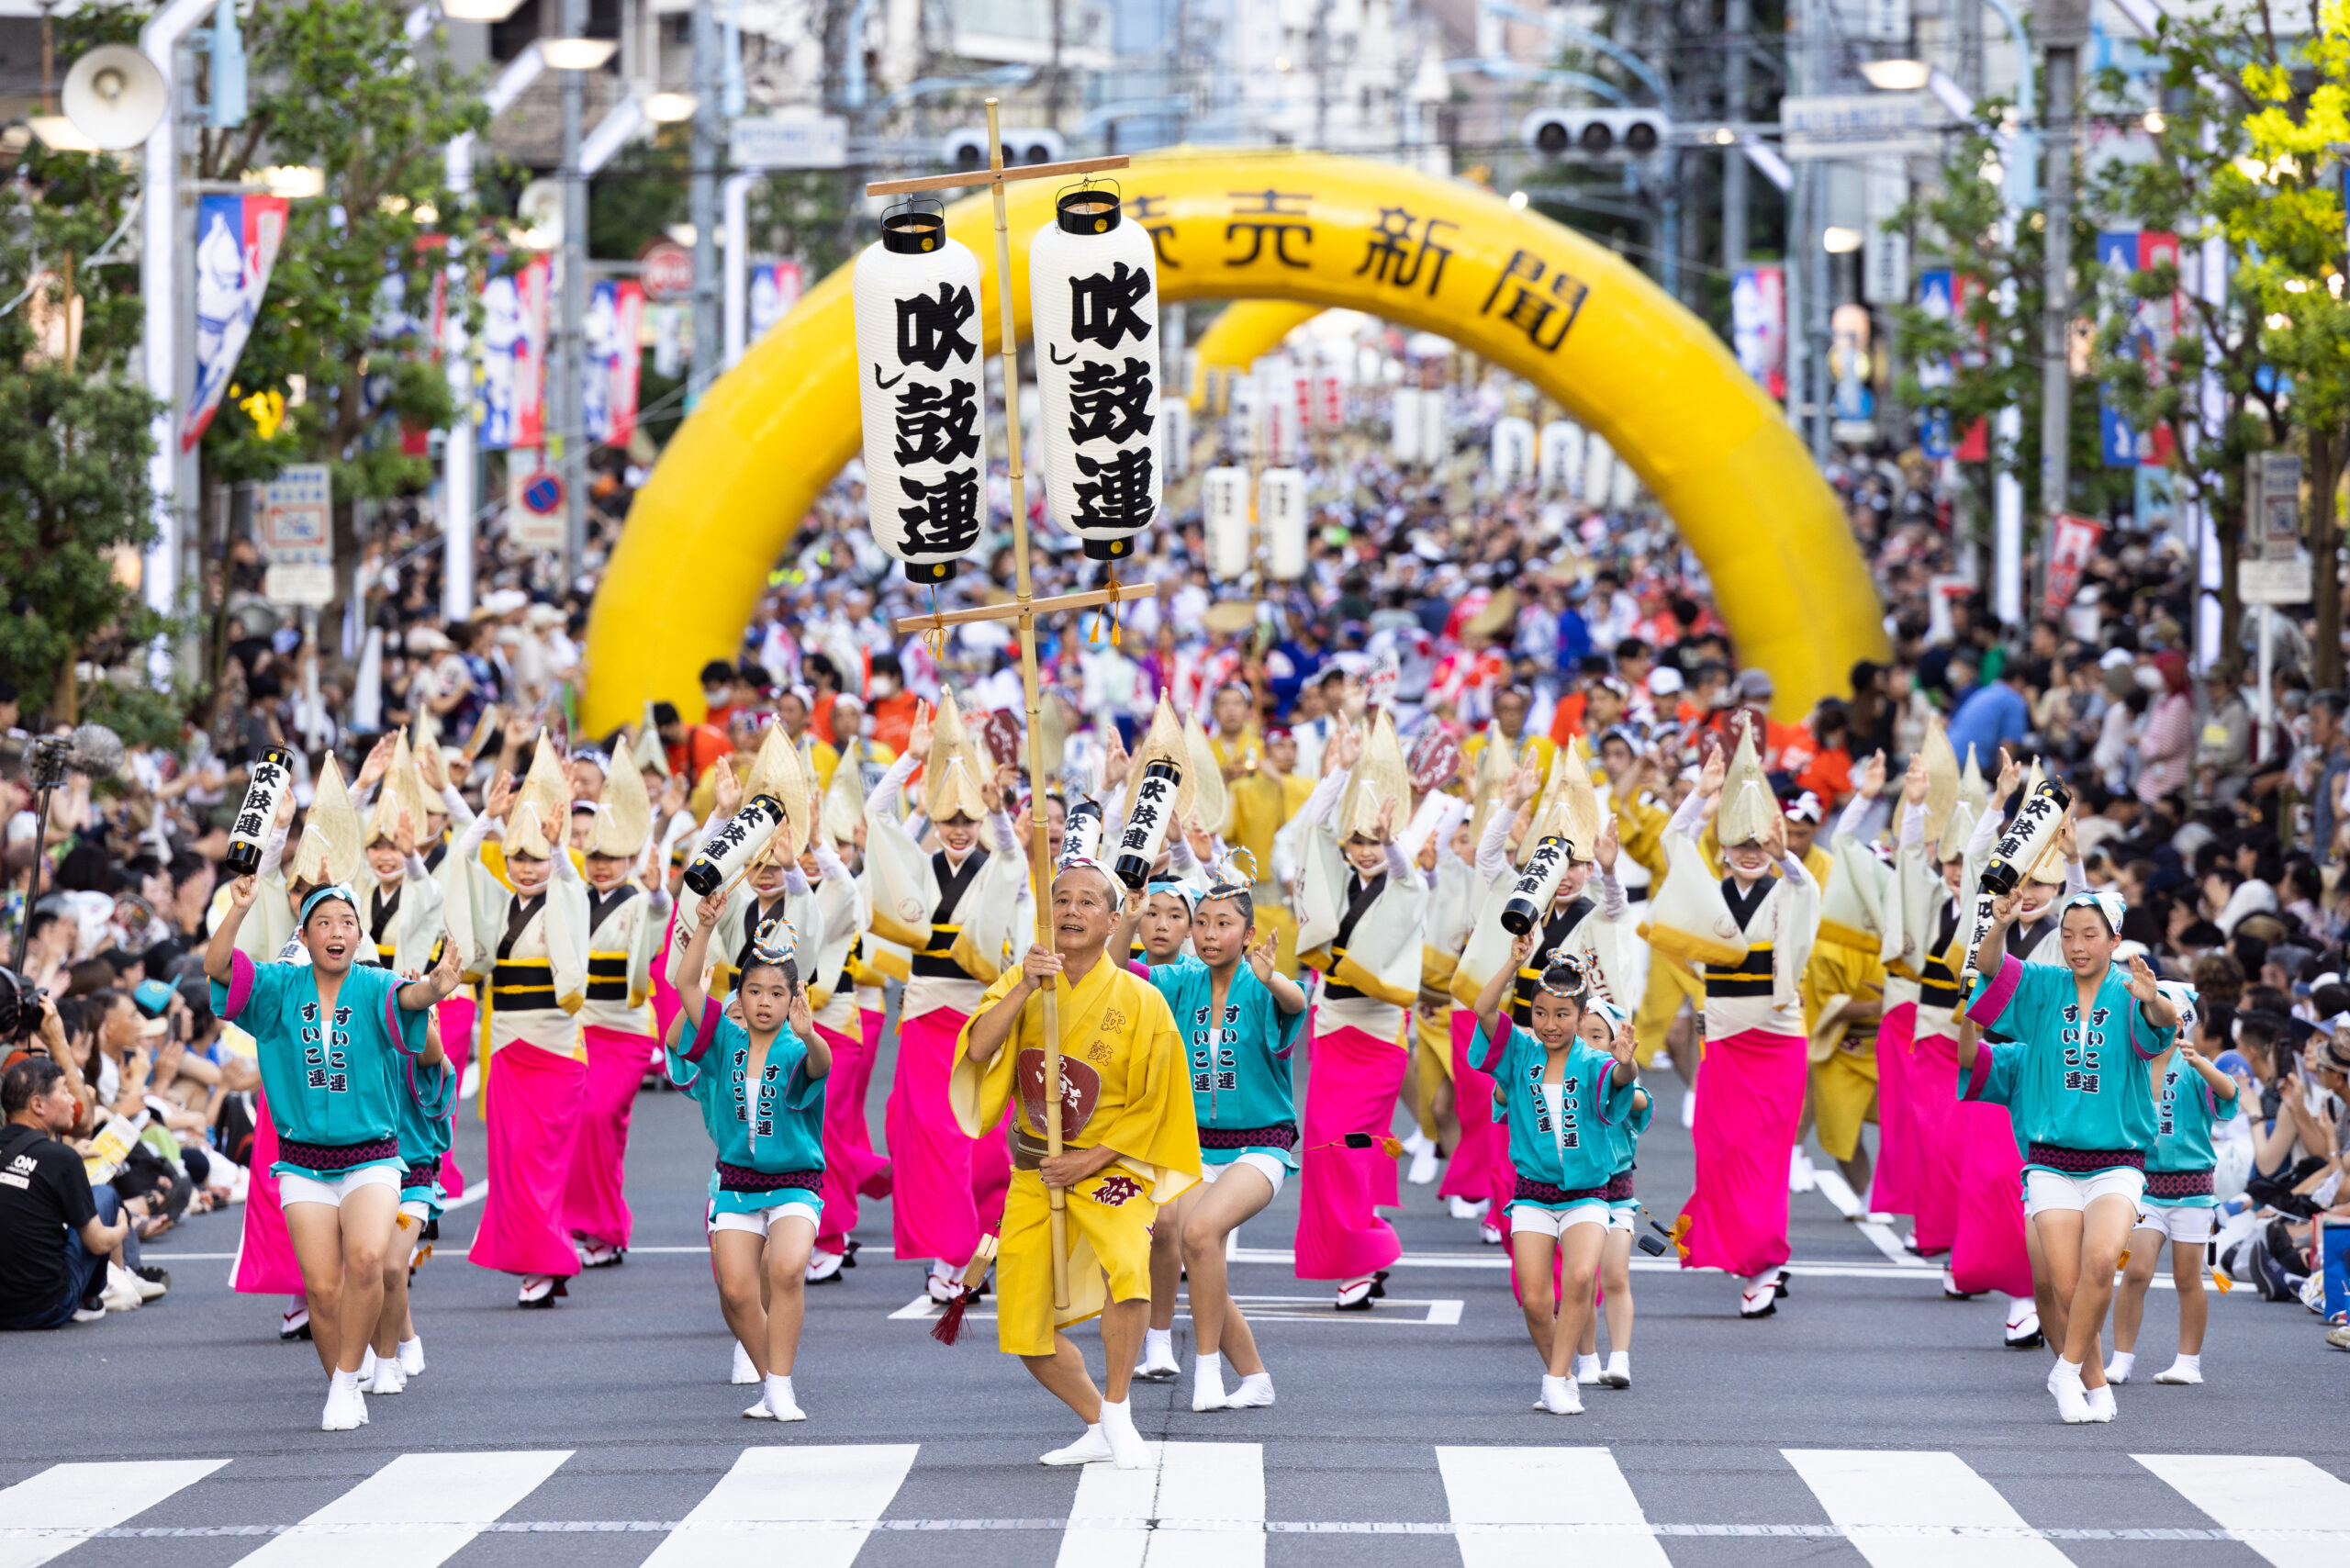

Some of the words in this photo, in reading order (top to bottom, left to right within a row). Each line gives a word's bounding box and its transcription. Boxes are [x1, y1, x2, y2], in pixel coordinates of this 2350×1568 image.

[301, 1002, 328, 1089] すいこ連
[329, 1006, 353, 1092] すいこ連
[732, 1048, 748, 1122] すいこ連
[1193, 1005, 1211, 1092] すいこ連
[1217, 1003, 1240, 1091] すいこ連
[2063, 1003, 2082, 1090] すいこ連
[2081, 1007, 2109, 1094] すいこ連
[756, 1064, 780, 1137] すいこ連
[1529, 1064, 1553, 1133] すいこ連
[1563, 1077, 1580, 1148] すいこ連
[2159, 1071, 2179, 1136] すいこ連
